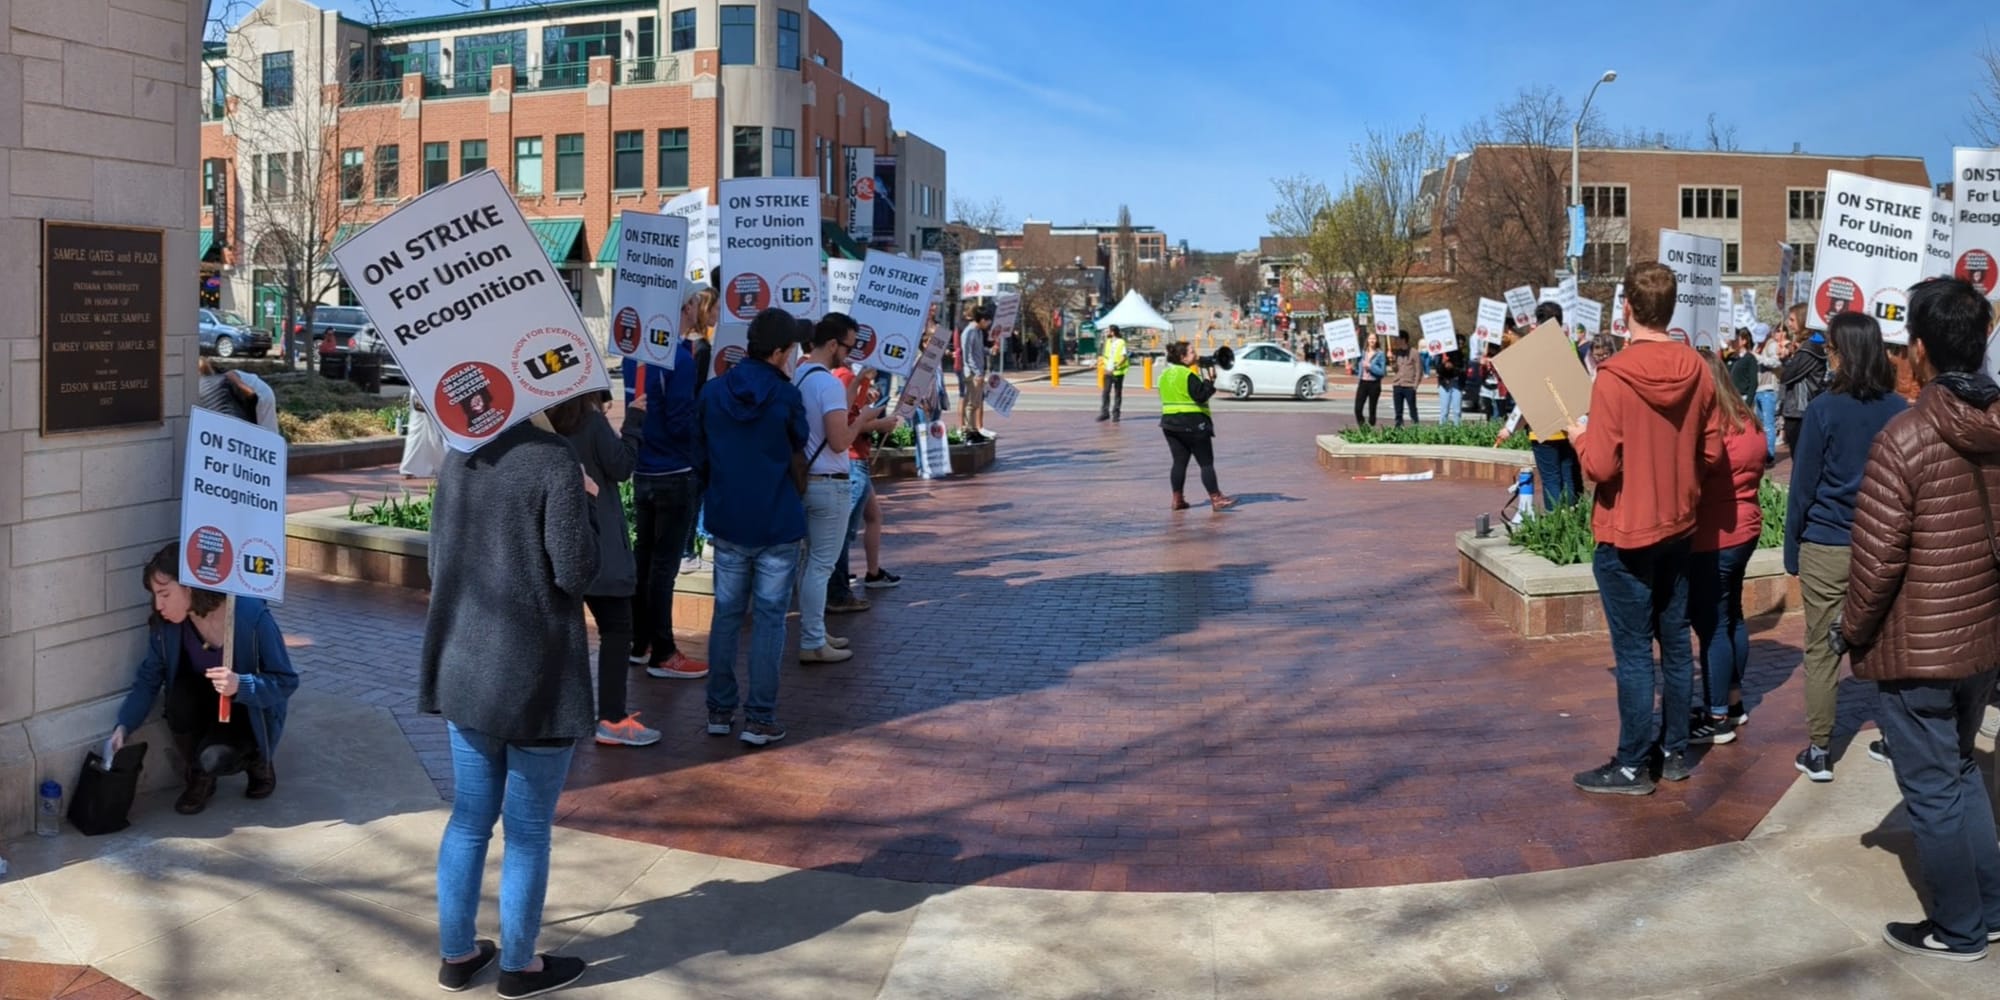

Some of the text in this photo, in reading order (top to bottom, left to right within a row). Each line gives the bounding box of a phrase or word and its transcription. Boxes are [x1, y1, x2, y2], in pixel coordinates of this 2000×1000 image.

[729, 195, 810, 209] ON STRIKE
[1837, 192, 1922, 219] ON STRIKE
[1967, 189, 1989, 203] For
[735, 214, 805, 229] For Union
[1840, 214, 1913, 240] For Union
[1931, 211, 1947, 225] ON
[364, 205, 504, 285] ON STRIKE
[625, 229, 639, 243] ON
[641, 232, 680, 248] STRIKE
[727, 235, 813, 250] Recognition
[1932, 229, 1949, 242] For
[53, 248, 158, 264] SAMPLE GATES and PLAZA
[1668, 249, 1717, 268] ON STRIKE
[1827, 233, 1918, 263] Recognition
[627, 250, 674, 269] For Union
[389, 243, 512, 309] For Union
[620, 268, 678, 290] Recognition
[869, 265, 886, 277] ON
[887, 268, 928, 286] STRIKE
[1674, 271, 1713, 286] or Union
[73, 282, 139, 292] INDIANA UNIVERSITY
[868, 280, 886, 292] For
[887, 284, 919, 300] Union
[394, 267, 545, 346] Recognition
[857, 294, 921, 317] Recognition
[60, 313, 151, 323] LOUISE WAITE SAMPLE
[441, 364, 477, 385] INDIANA
[442, 368, 484, 393] GRADUATE
[60, 379, 148, 393] EDSON WAITE SAMPLE
[447, 374, 485, 397] WORKERS
[449, 379, 491, 405] COALITION
[200, 431, 277, 466] ON STRIKE
[204, 455, 271, 487] For Union
[194, 477, 278, 512] Recognition
